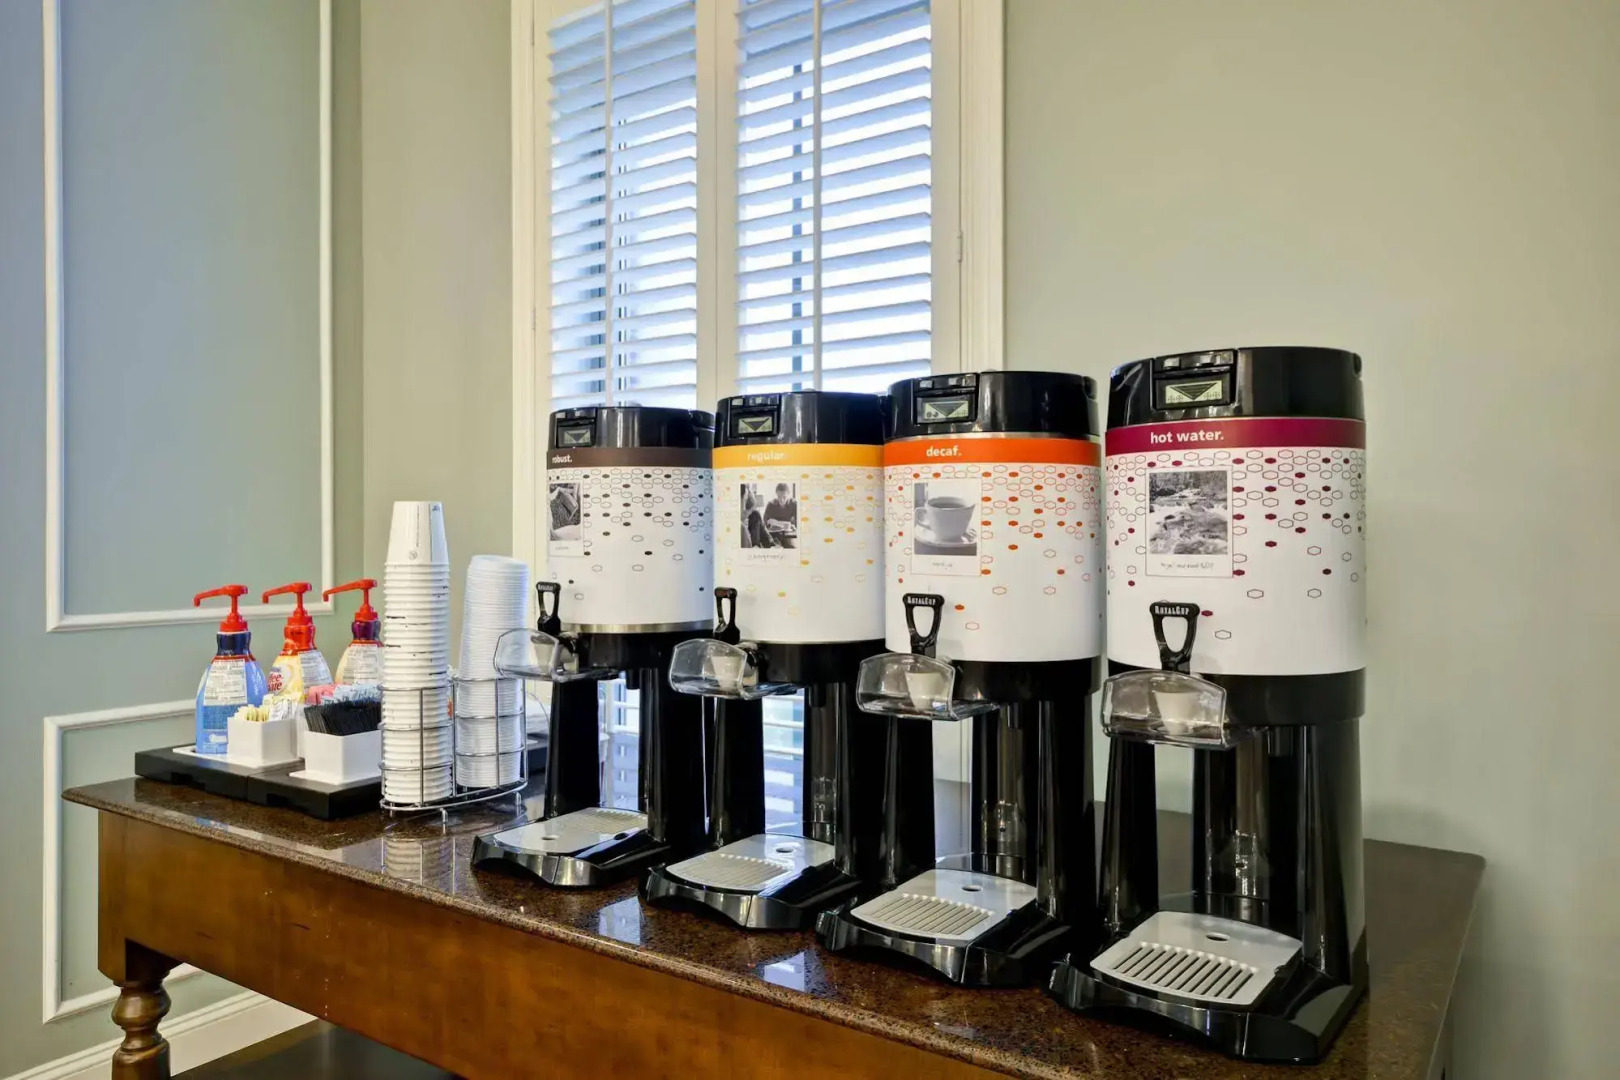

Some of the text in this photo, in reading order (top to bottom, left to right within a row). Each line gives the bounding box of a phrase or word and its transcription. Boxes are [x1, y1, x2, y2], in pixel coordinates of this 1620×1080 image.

[1150, 430, 1224, 444] hot water.
[926, 445, 962, 457] decaf.
[551, 454, 573, 463] robust.
